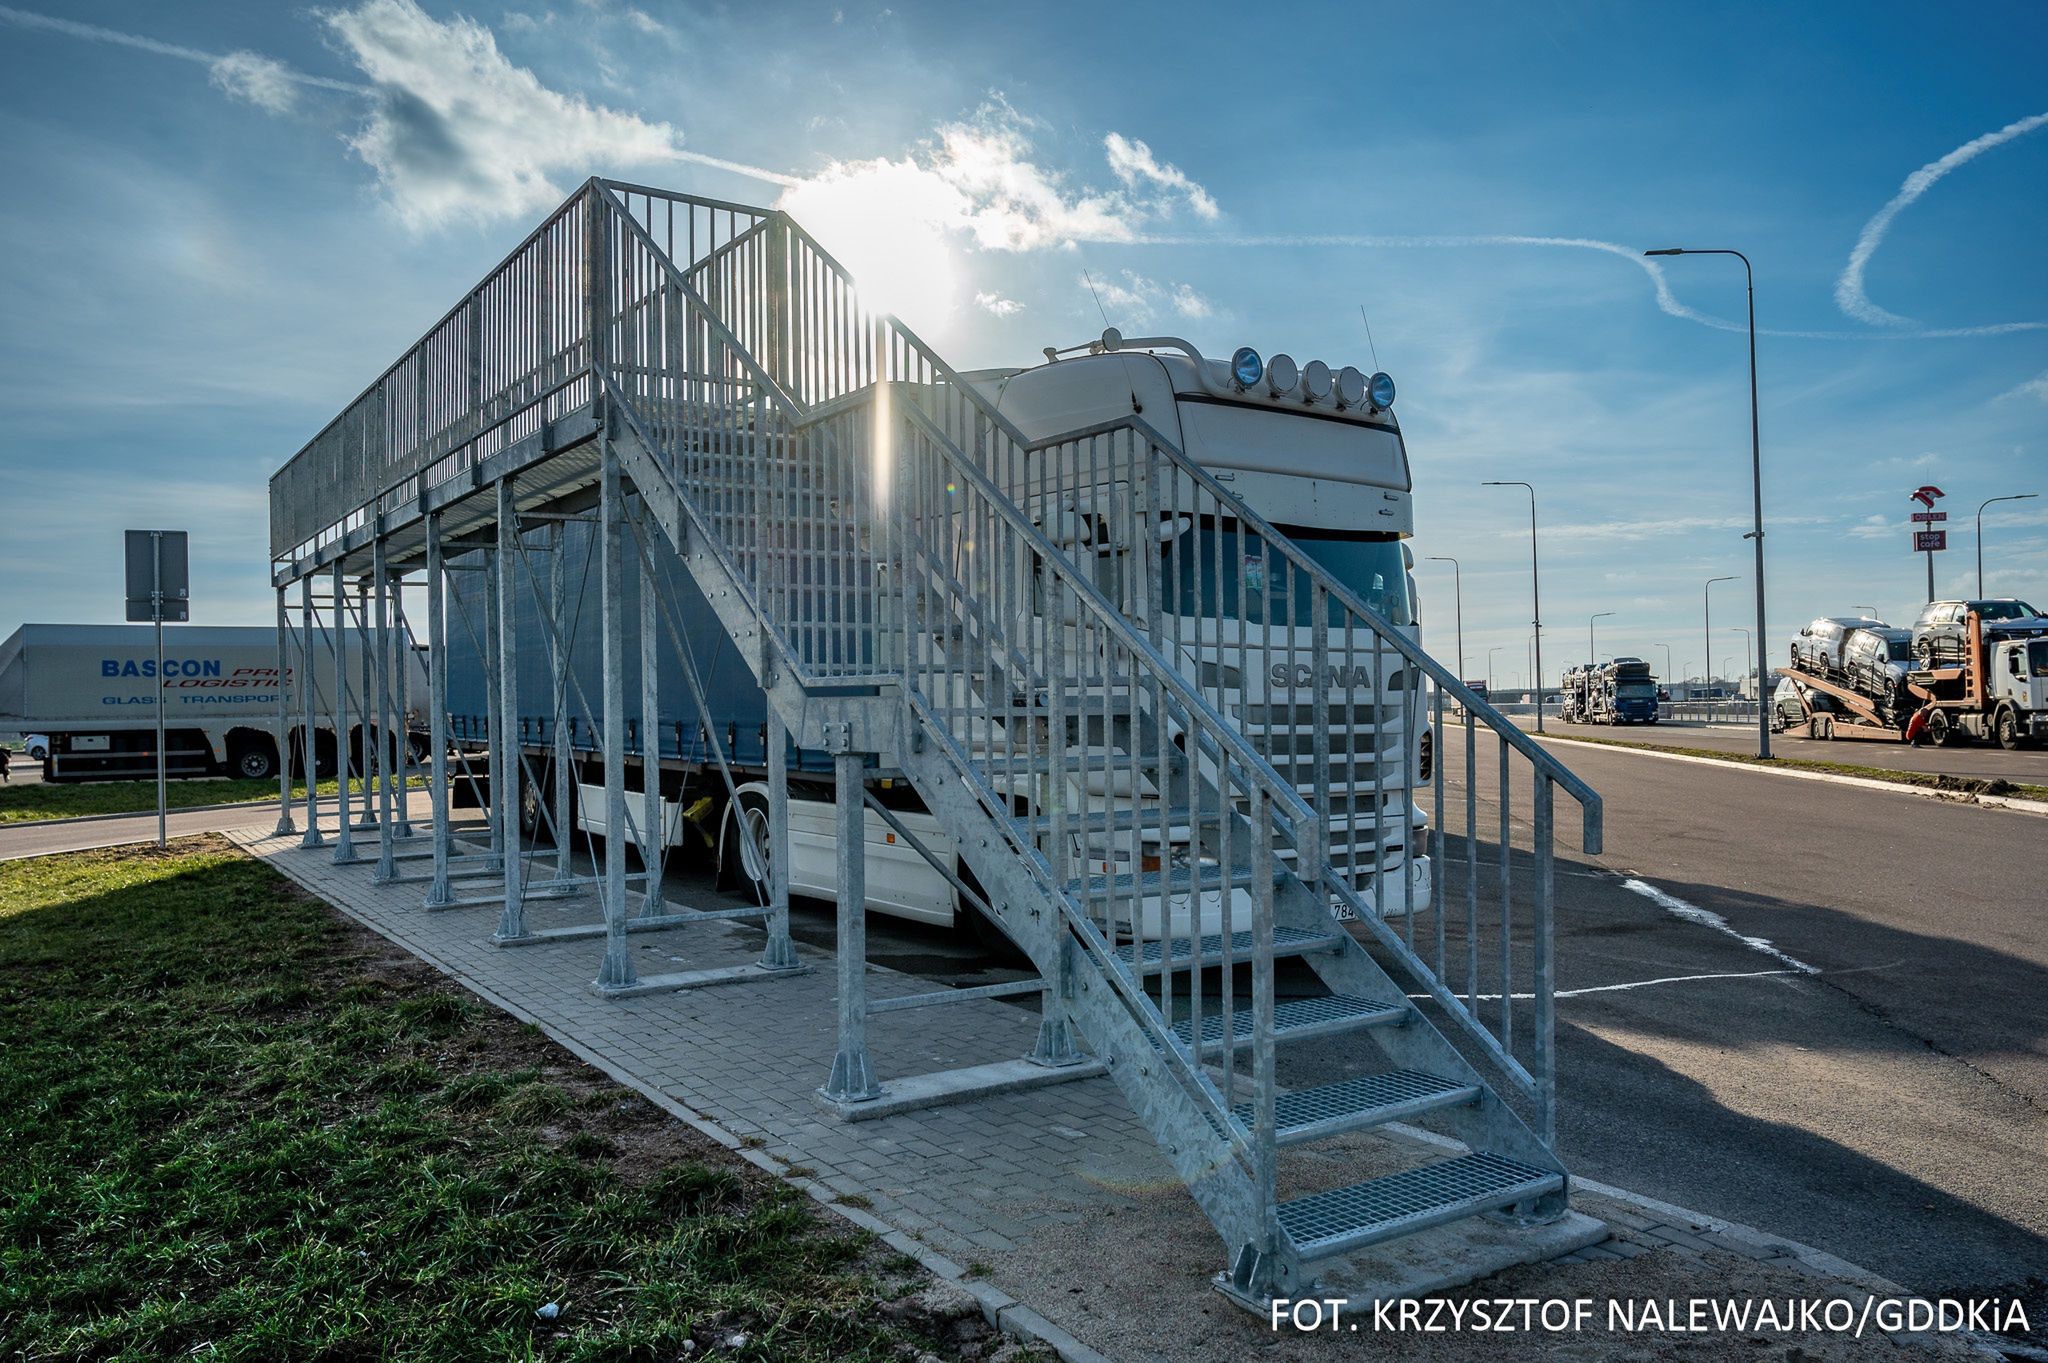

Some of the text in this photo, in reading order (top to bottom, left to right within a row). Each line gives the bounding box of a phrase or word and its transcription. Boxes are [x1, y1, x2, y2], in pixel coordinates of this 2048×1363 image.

[1920, 533, 1940, 541] stop
[102, 659, 293, 677] BASCON PRO
[1270, 663, 1371, 689] SCNA
